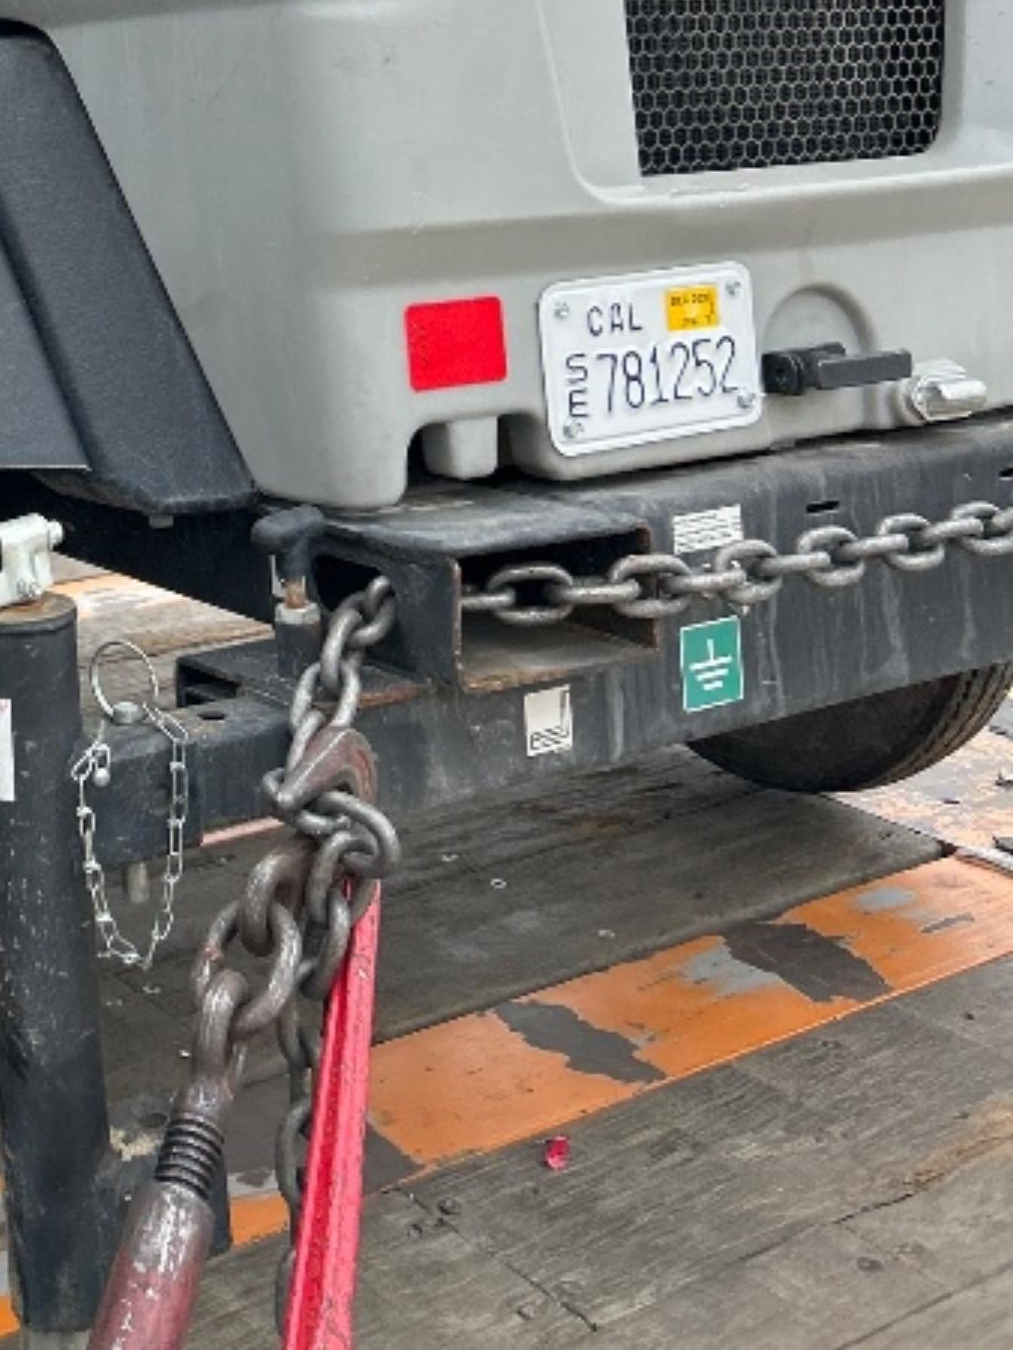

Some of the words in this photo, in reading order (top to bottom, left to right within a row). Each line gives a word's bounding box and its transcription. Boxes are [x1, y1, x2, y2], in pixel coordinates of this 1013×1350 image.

[587, 302, 643, 337] CAL
[565, 352, 589, 418] SE
[596, 335, 739, 414] 781252
